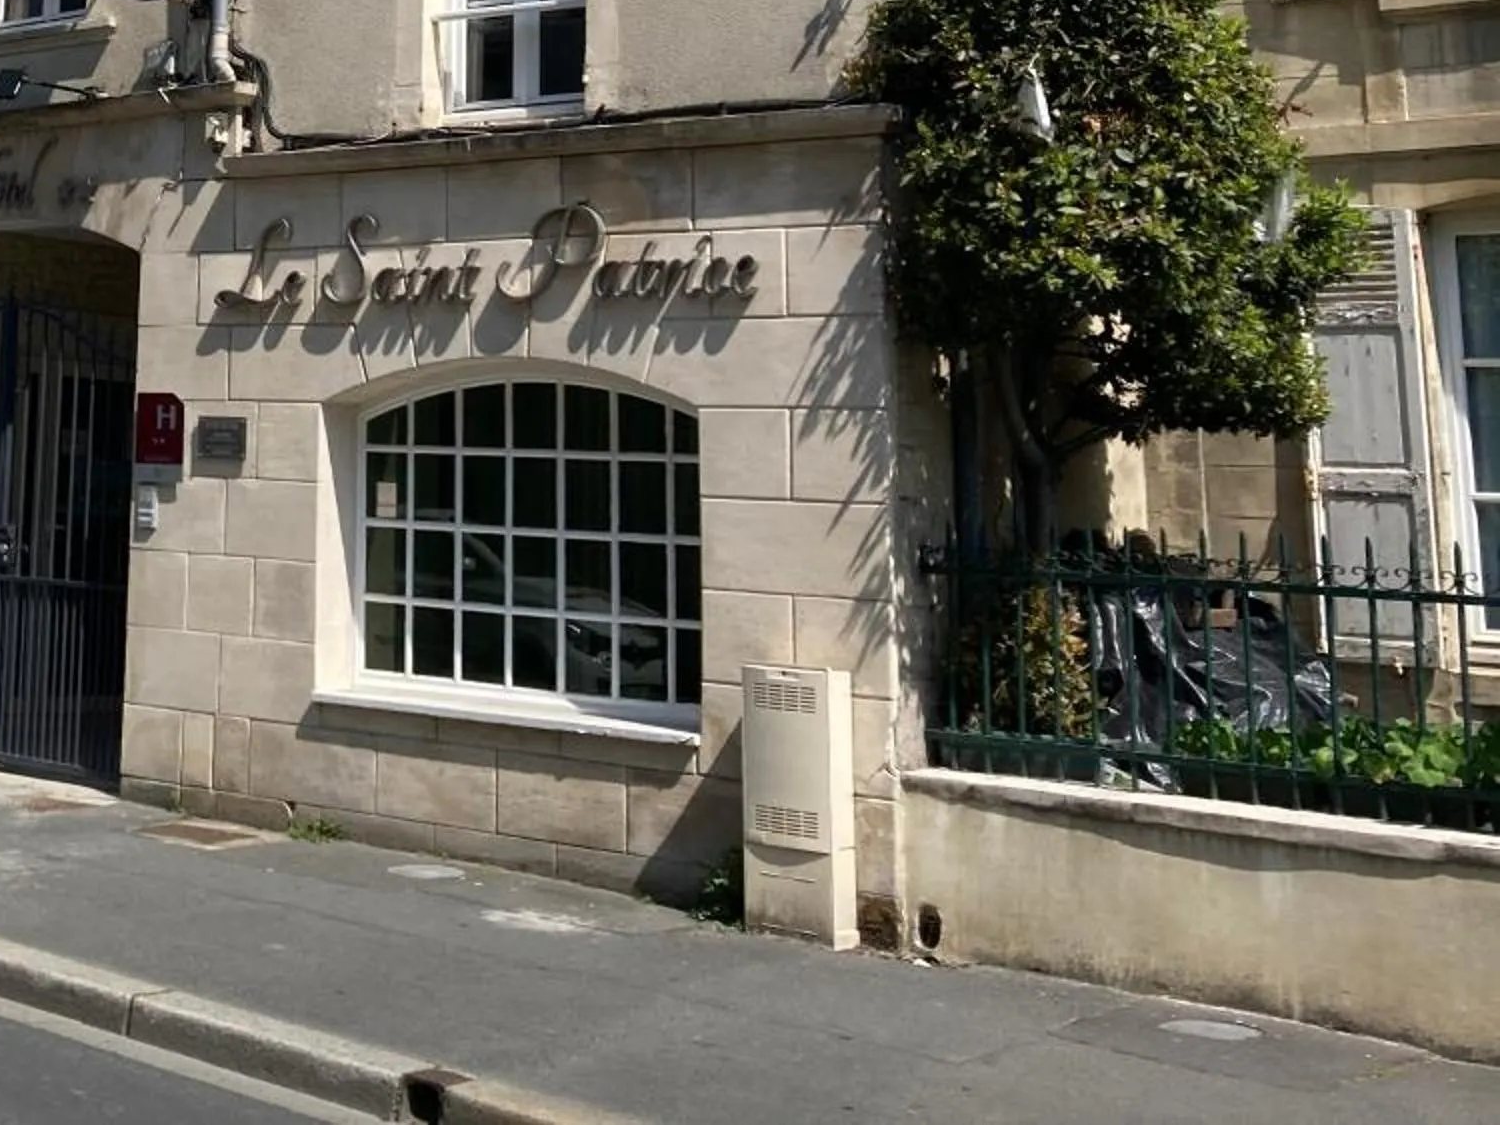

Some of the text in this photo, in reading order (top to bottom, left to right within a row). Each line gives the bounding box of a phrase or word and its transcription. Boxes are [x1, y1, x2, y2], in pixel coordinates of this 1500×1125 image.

[214, 200, 760, 308] Le Saint Patrice
[156, 404, 177, 431] H
